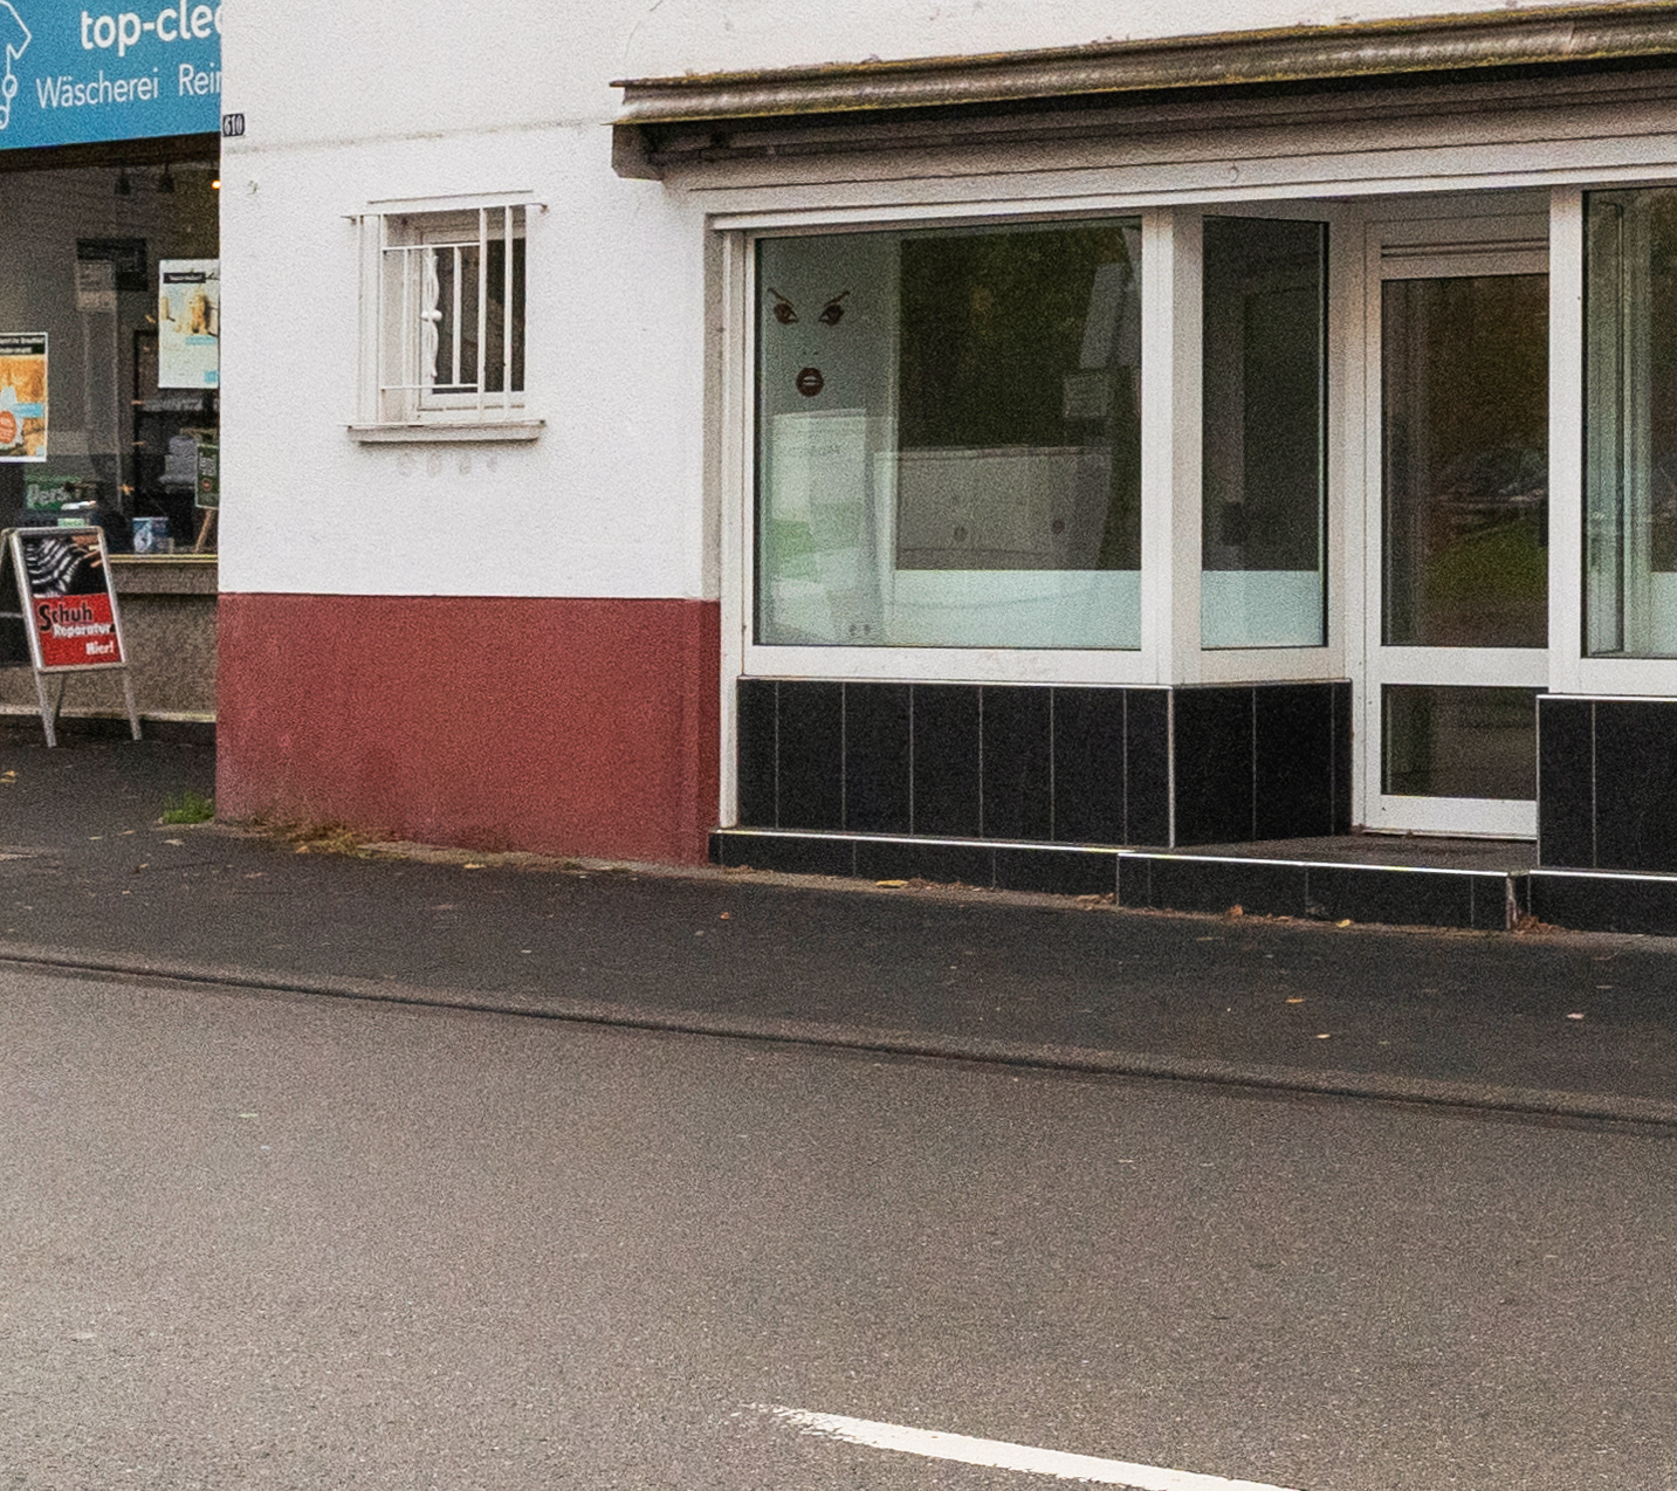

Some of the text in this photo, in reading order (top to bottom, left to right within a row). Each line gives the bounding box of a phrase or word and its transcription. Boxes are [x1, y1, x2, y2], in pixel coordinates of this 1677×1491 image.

[35, 67, 159, 109] Wäscherei
[223, 113, 244, 136] 610
[38, 601, 93, 632] Schuh
[53, 623, 111, 638] Reparatur
[85, 640, 114, 656] Hier!
